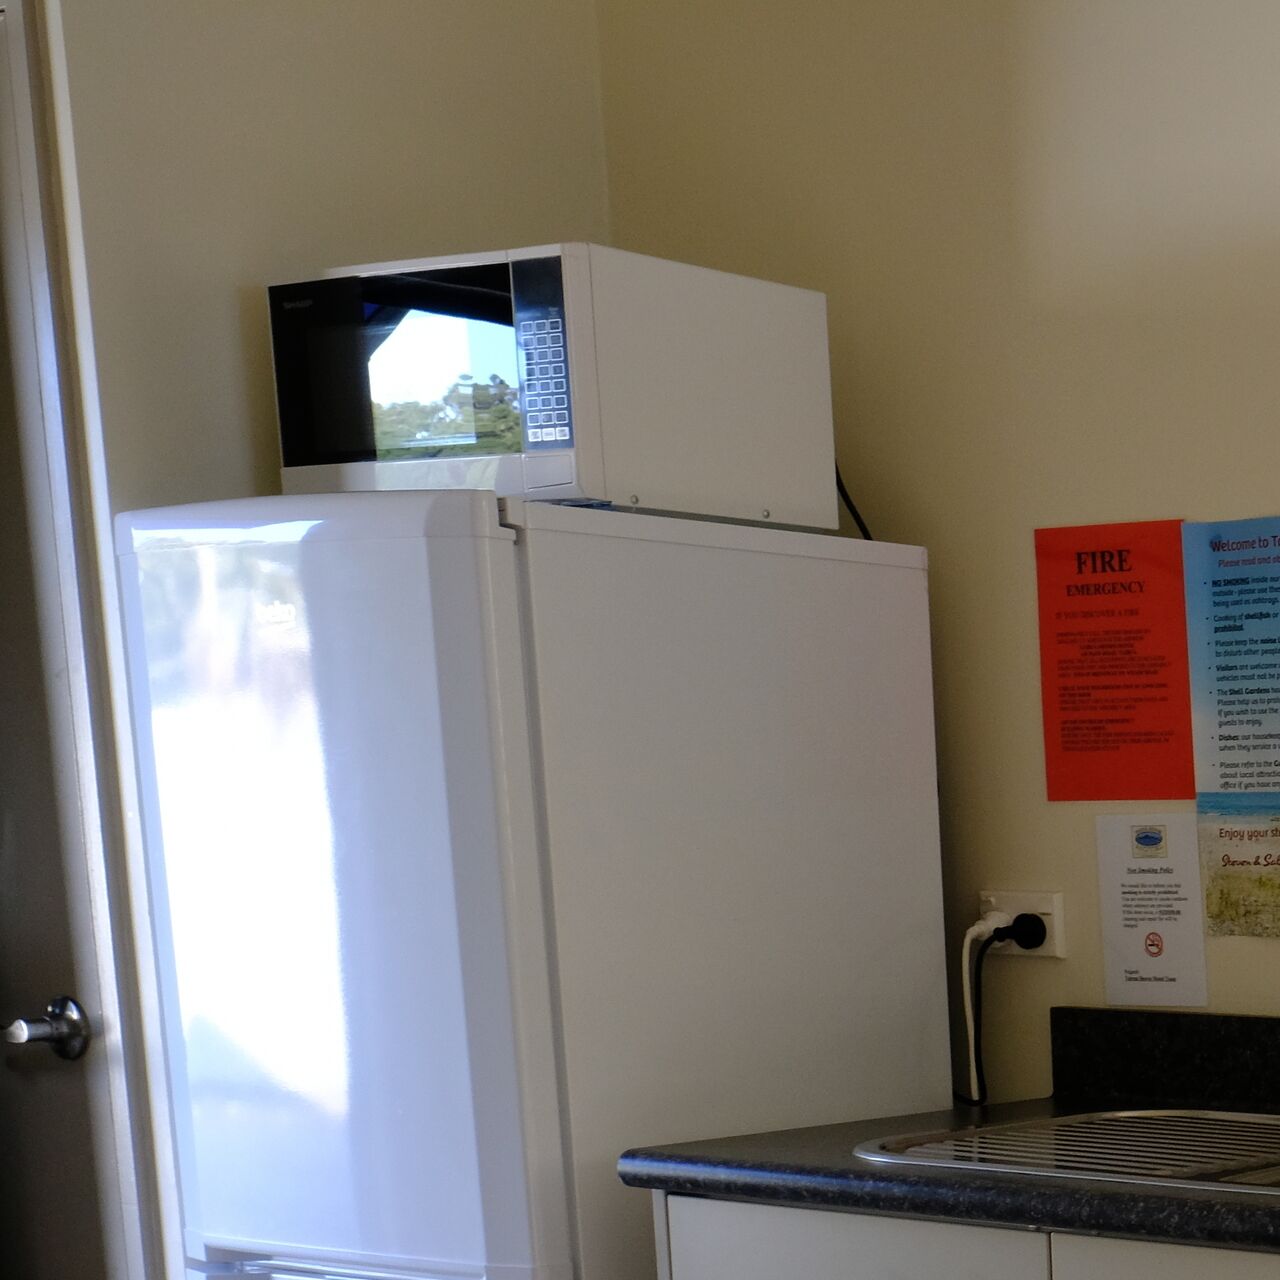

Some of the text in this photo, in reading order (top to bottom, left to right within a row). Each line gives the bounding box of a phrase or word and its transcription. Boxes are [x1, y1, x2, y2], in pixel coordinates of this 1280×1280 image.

[1209, 537, 1256, 552] Welcome
[1257, 536, 1268, 548] to
[1075, 549, 1132, 574] FIRE
[1065, 580, 1145, 596] EMERGENCY
[1219, 828, 1245, 840] Enjoy
[1247, 830, 1268, 840] your
[1253, 856, 1260, 865] &
